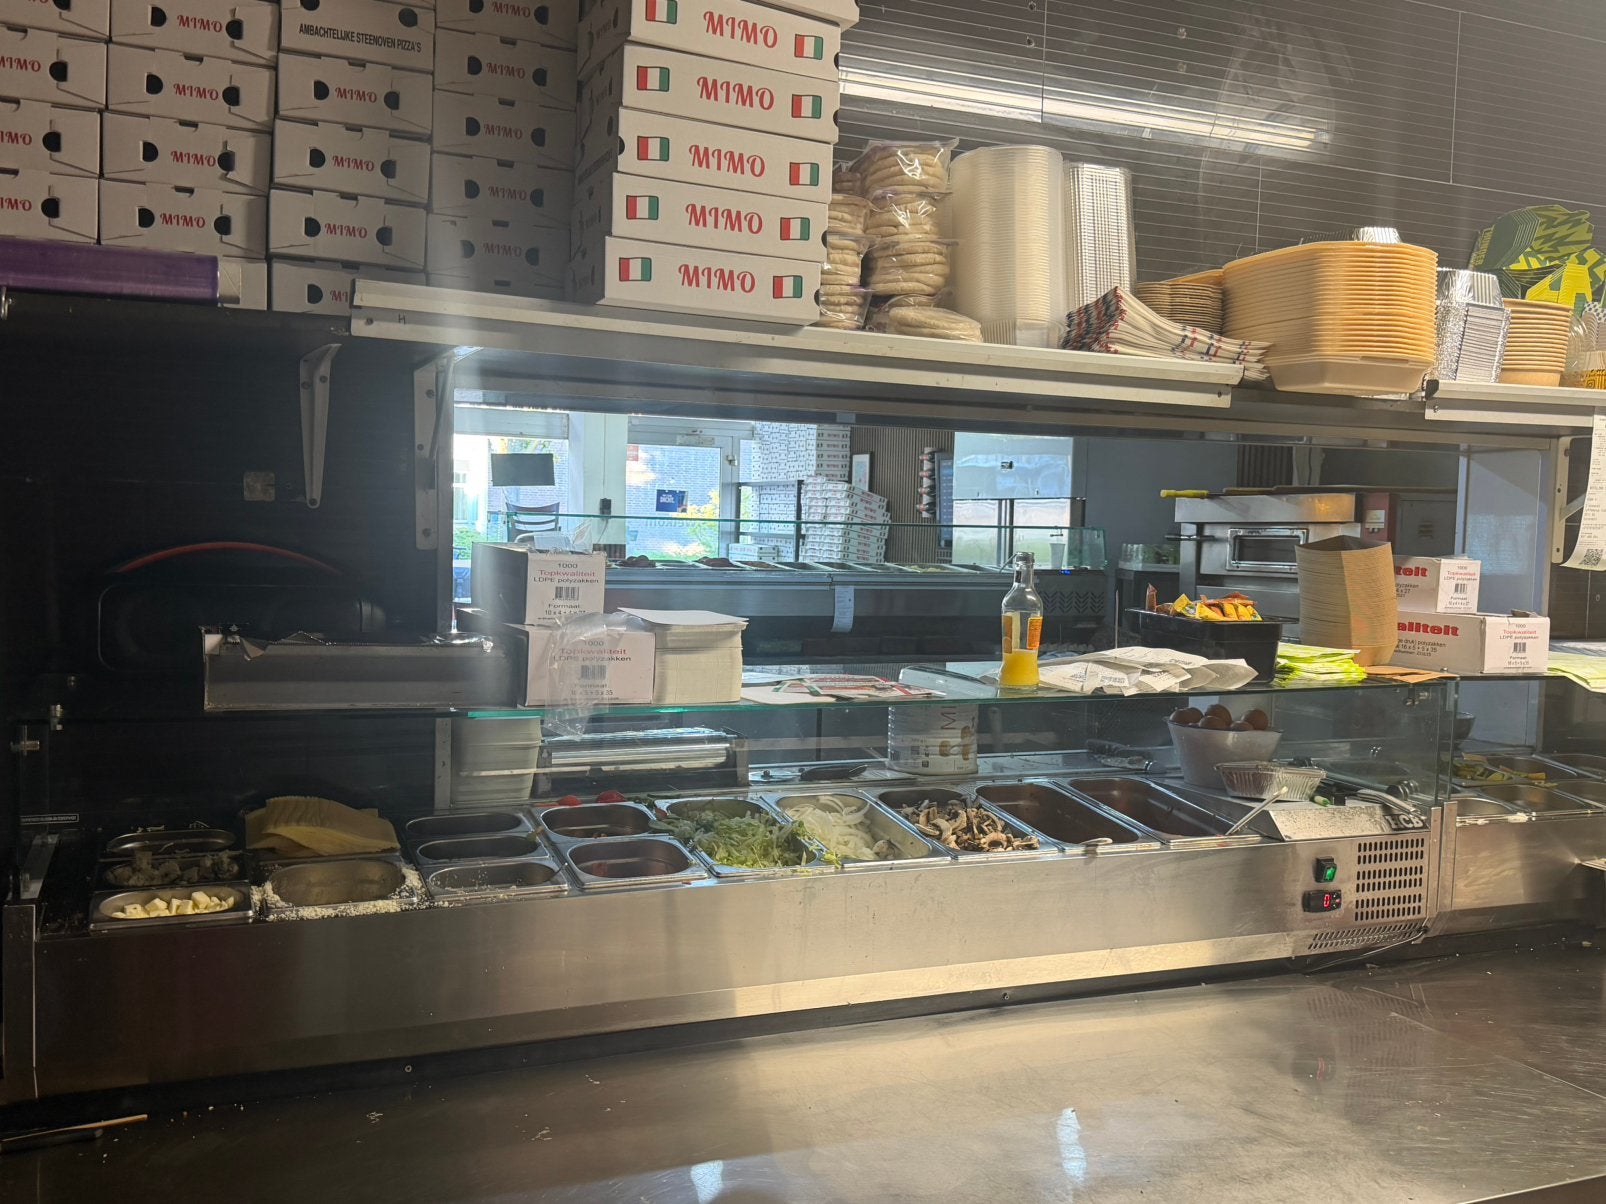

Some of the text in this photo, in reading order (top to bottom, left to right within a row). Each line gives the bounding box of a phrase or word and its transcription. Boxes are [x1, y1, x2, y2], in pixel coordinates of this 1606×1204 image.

[177, 14, 223, 33] MIMO
[703, 10, 778, 48] MIMO
[299, 23, 422, 53] AMBACHTELIJKE STEENOVEN PIZZA'S
[173, 83, 219, 101] MIMO
[335, 87, 377, 103] MIMO
[697, 76, 775, 110] MIMO
[0, 131, 32, 145] IMO
[170, 150, 217, 167] MIMO
[332, 155, 375, 172] MIMO
[689, 144, 766, 178] MIMO
[160, 212, 206, 228] MIMO
[685, 203, 763, 235] MIMO
[325, 222, 368, 239] MIMO
[678, 263, 756, 294] MIMO
